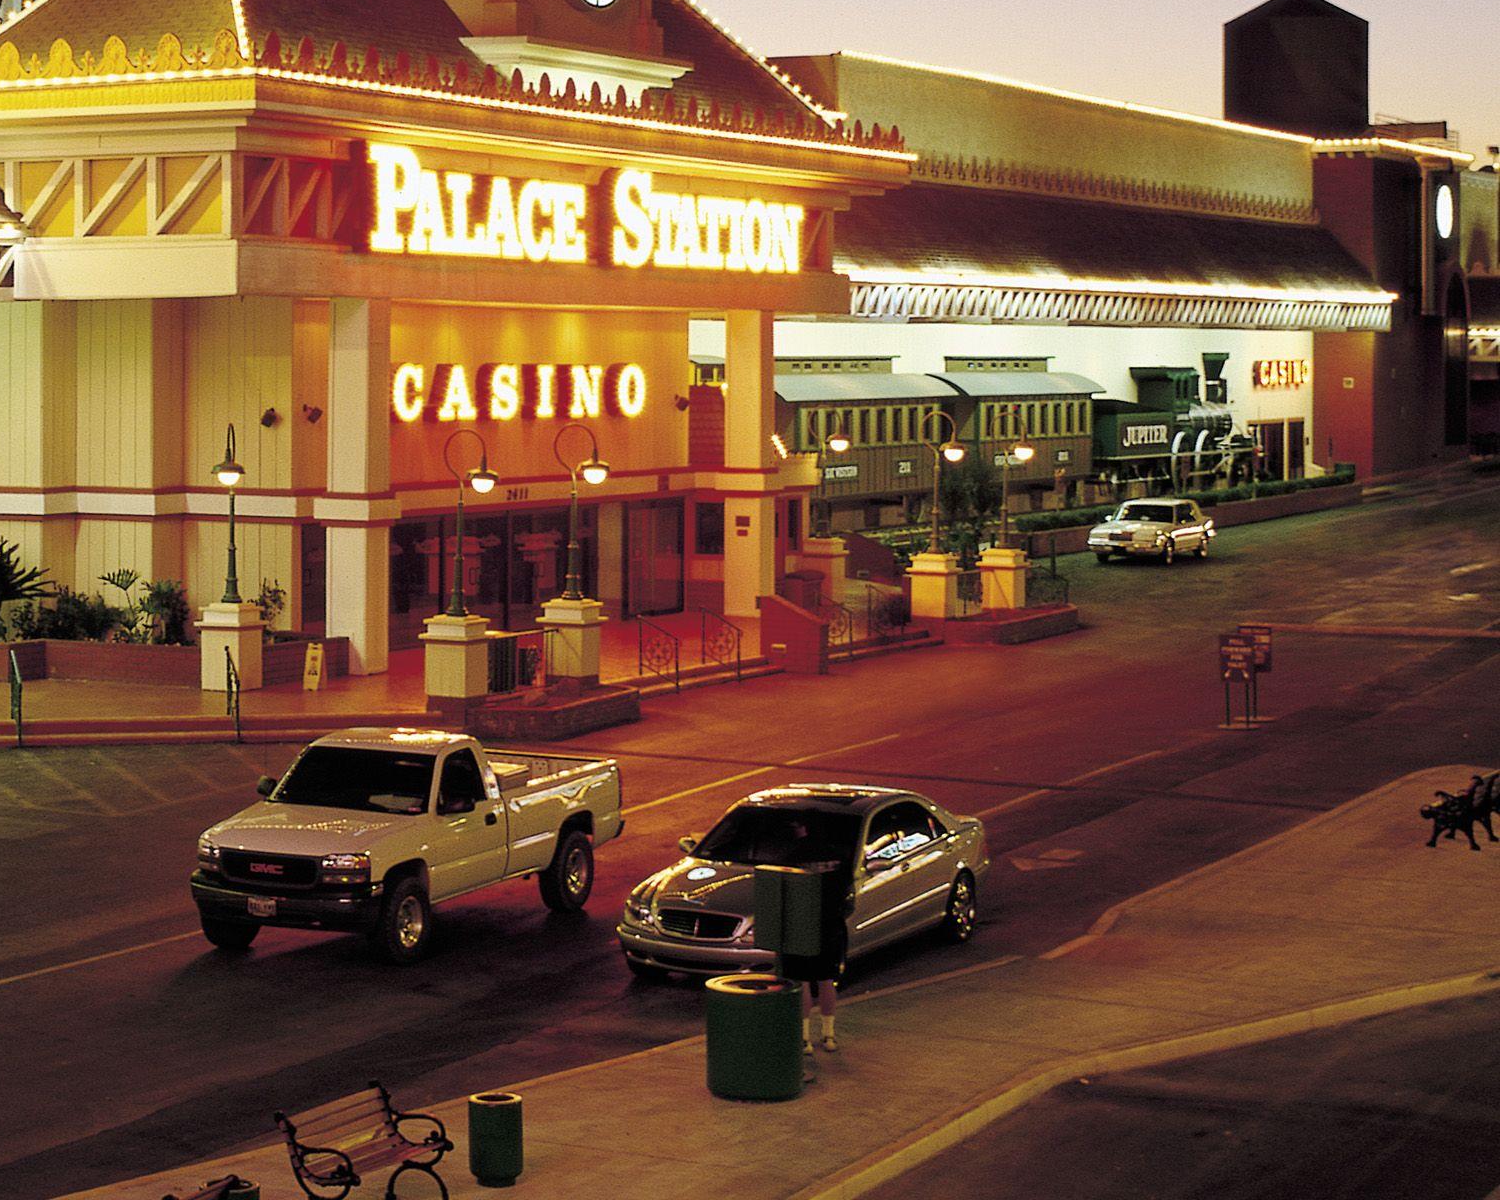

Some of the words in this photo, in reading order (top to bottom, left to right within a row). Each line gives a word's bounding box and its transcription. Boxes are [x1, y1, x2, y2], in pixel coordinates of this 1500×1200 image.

[368, 144, 587, 263] PALACE
[612, 168, 804, 274] STATION
[1259, 359, 1310, 386] CASINO
[391, 362, 647, 422] CASINO
[1123, 424, 1168, 447] JUPITER
[506, 487, 529, 501] 2411
[249, 862, 284, 876] GMC
